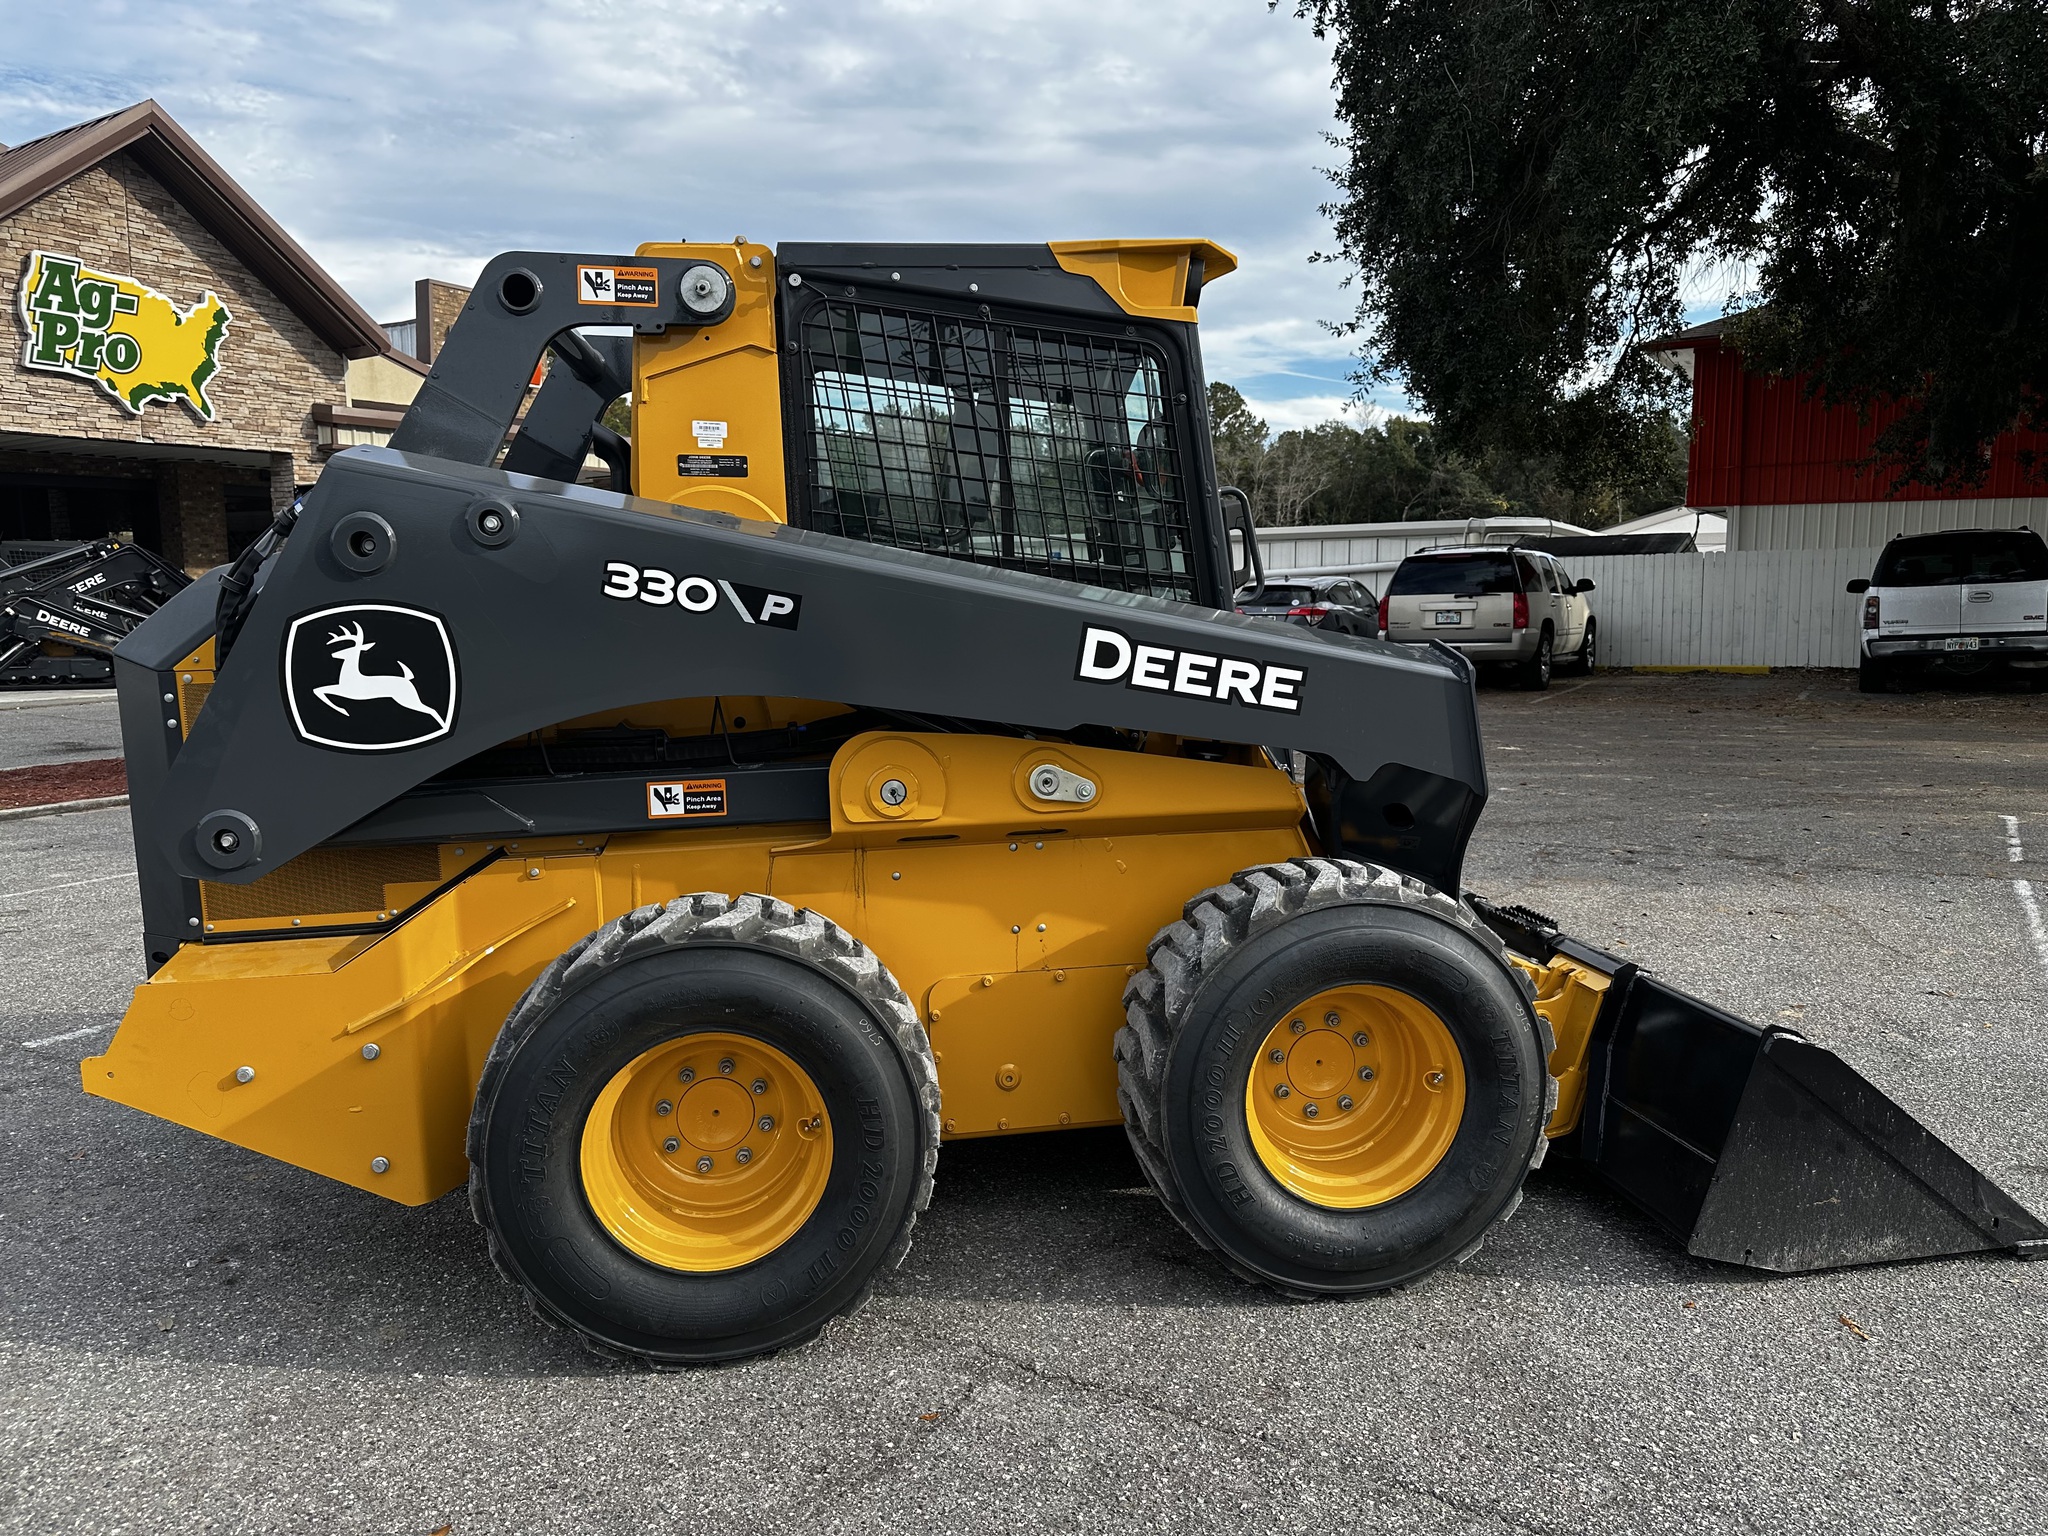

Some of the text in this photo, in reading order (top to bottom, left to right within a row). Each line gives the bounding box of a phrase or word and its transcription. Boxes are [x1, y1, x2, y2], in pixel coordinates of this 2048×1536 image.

[31, 258, 138, 331] Ag-
[617, 283, 653, 292] Pinch Area
[624, 270, 654, 278] WARNING
[33, 313, 140, 372] Pro
[602, 561, 794, 621] 330 P
[36, 609, 91, 637] DEERE
[1080, 627, 1303, 710] DEERE
[1203, 1063, 1229, 1155] 2000
[1490, 1028, 1521, 1149] TITAN
[519, 1054, 578, 1184] TITAN
[856, 1097, 886, 1152] HD
[838, 1160, 885, 1252] 2000
[1216, 1159, 1256, 1210] HD
